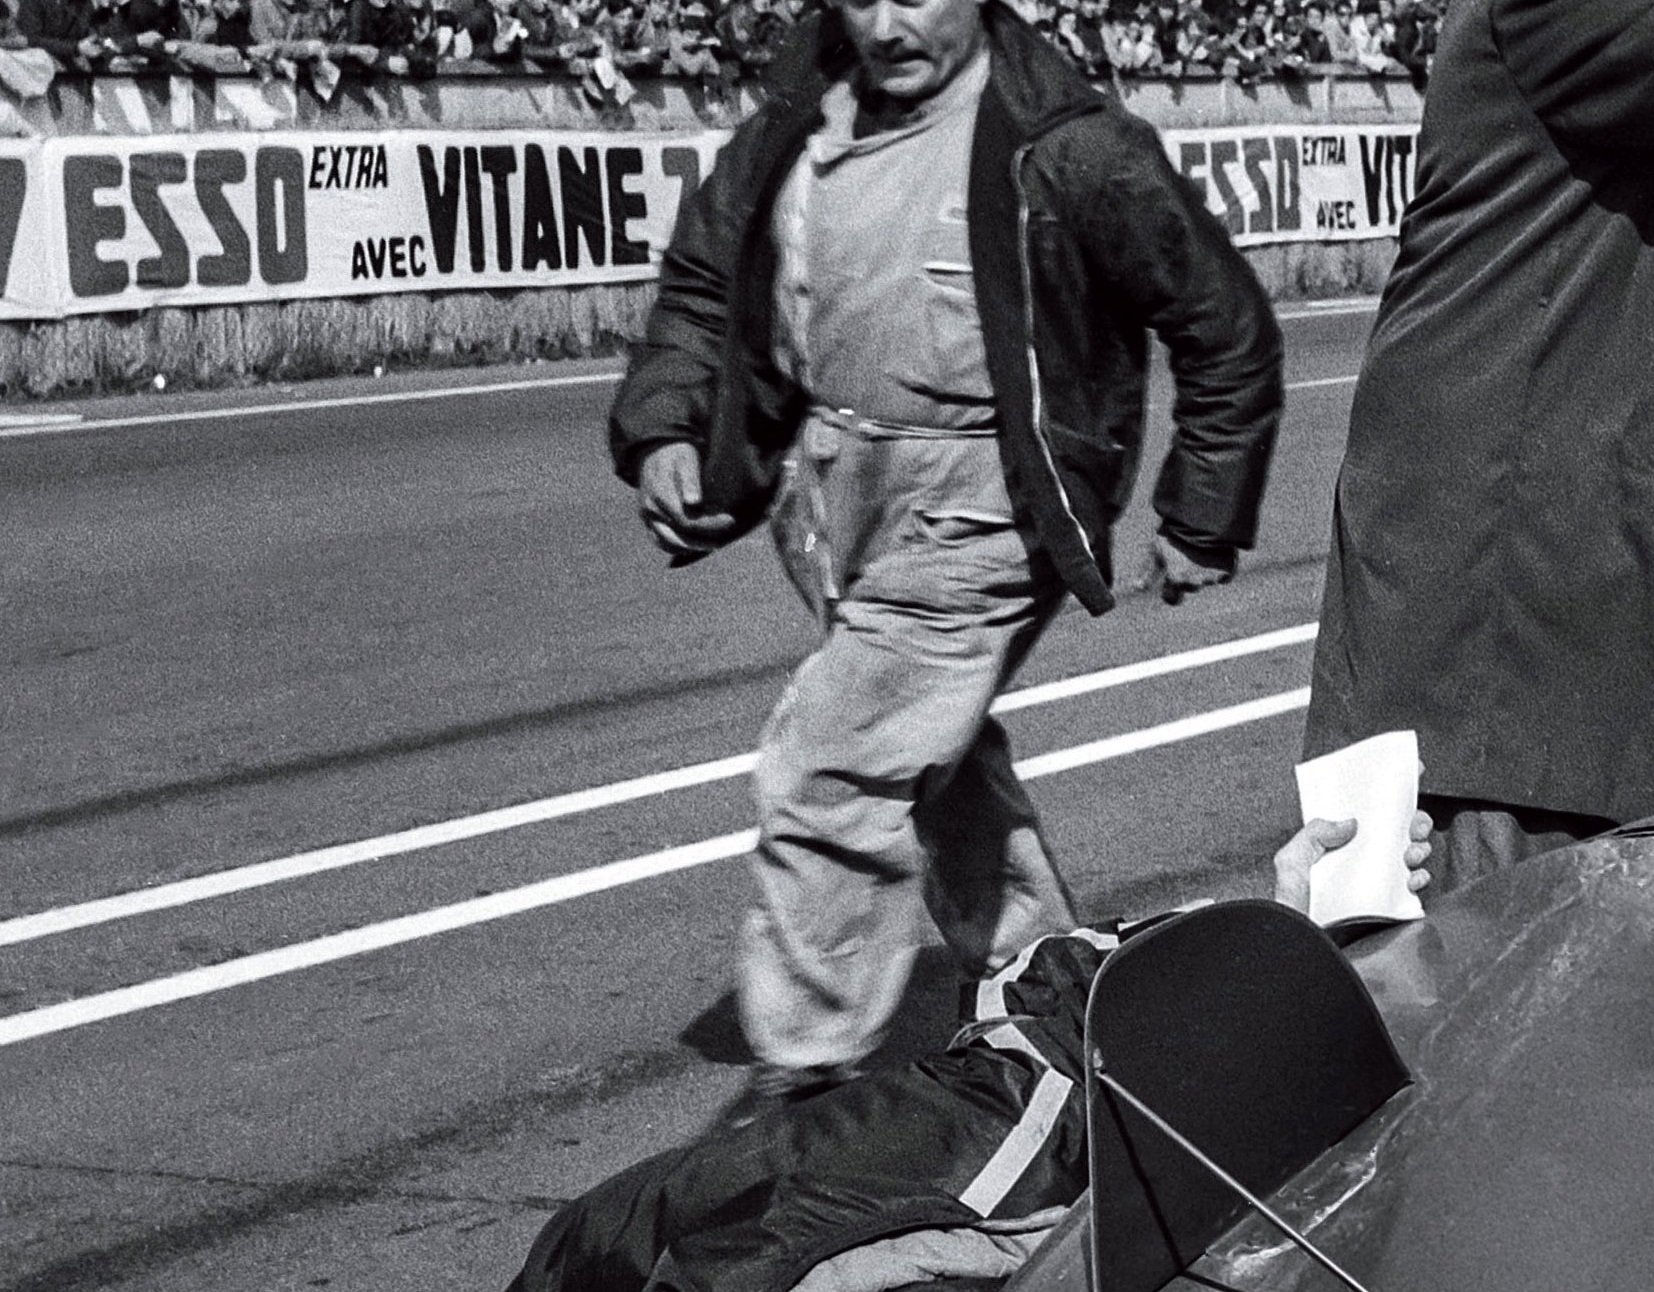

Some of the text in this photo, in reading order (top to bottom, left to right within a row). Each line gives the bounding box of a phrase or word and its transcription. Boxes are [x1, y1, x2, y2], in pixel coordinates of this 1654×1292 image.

[1302, 135, 1347, 166] EXTRA
[1180, 135, 1301, 234] ESSO
[1316, 199, 1356, 230] AVEC
[63, 145, 309, 298] ESSO
[309, 143, 389, 192] EXTRA
[351, 234, 428, 280] AVEC
[417, 142, 651, 275] VITANE
